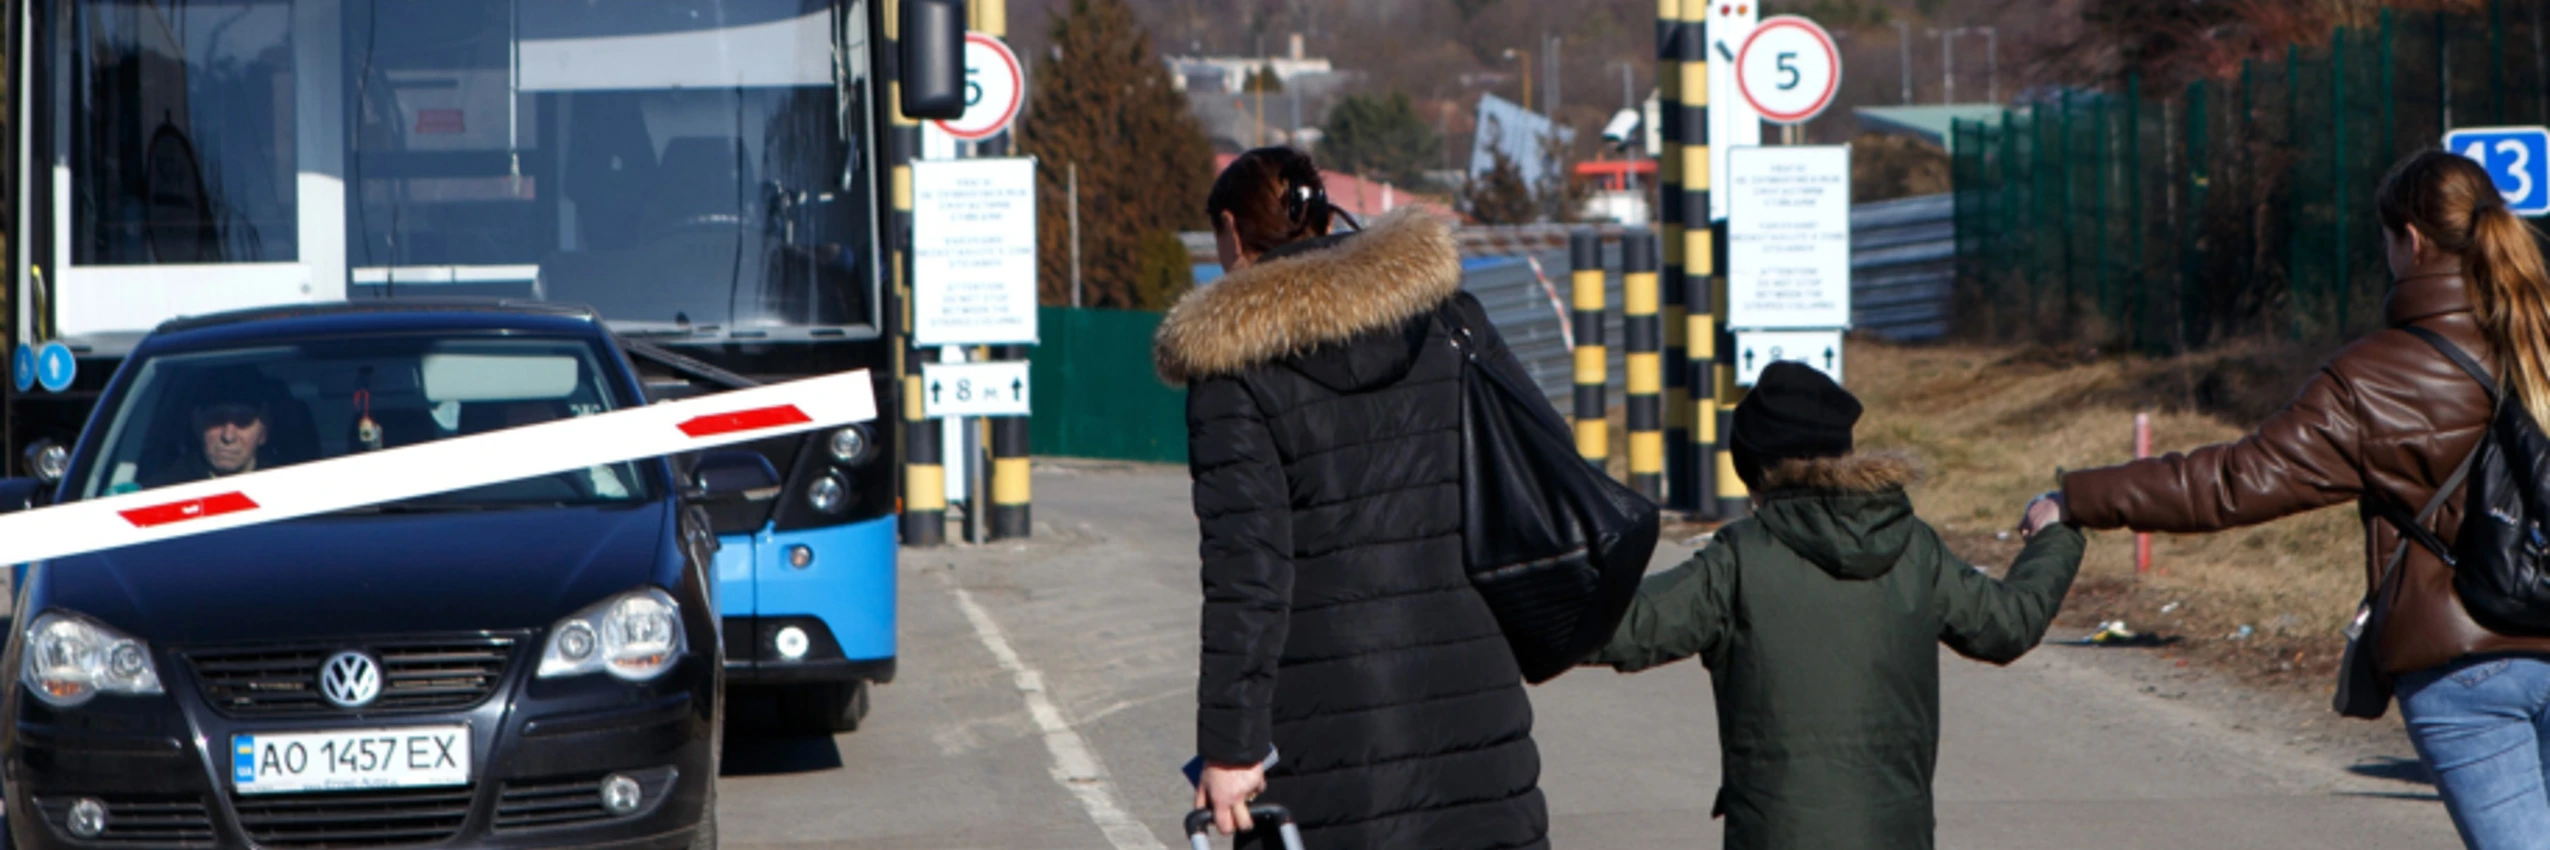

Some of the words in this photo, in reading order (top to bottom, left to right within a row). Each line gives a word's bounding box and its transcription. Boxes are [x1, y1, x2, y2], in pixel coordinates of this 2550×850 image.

[965, 67, 983, 107] 5
[1776, 51, 1800, 91] 5
[956, 378, 972, 402] 8
[260, 741, 308, 776] AO
[320, 737, 398, 774] 1457
[407, 734, 457, 770] EX
